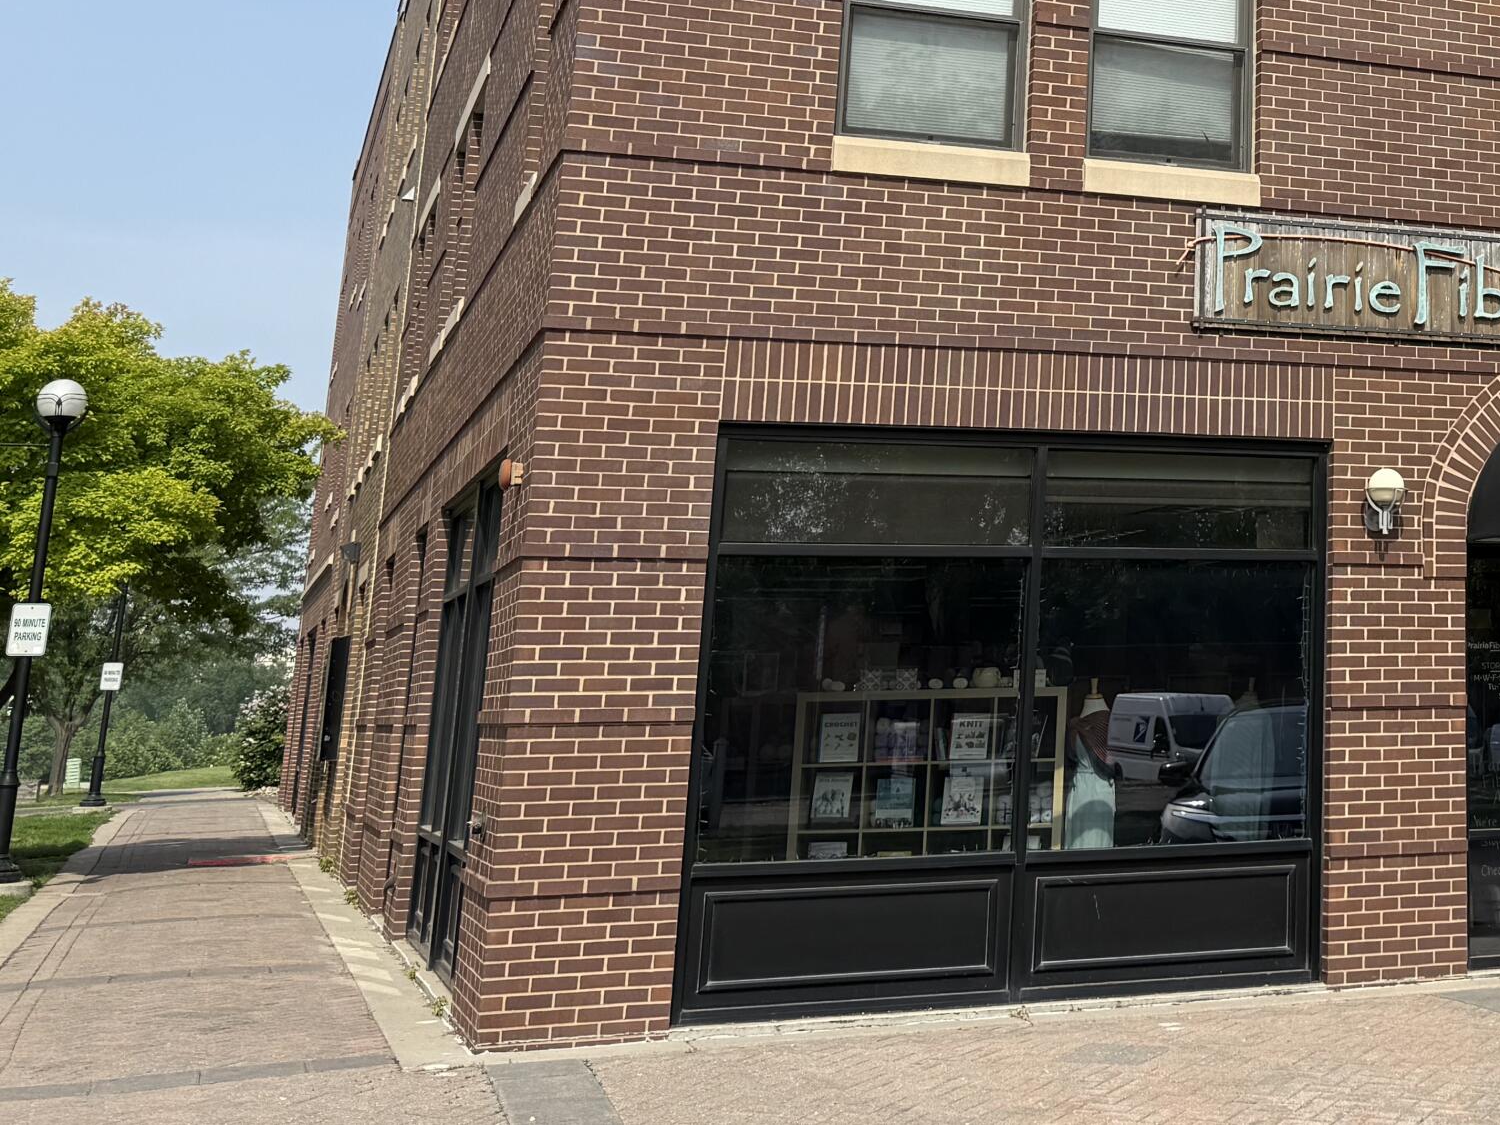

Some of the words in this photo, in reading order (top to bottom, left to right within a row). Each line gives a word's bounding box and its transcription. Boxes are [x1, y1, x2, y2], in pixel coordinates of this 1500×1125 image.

[1212, 225, 1401, 314] Prairie
[22, 618, 46, 628] MINUTE
[13, 631, 42, 641] PARKING
[959, 720, 985, 728] KNIT
